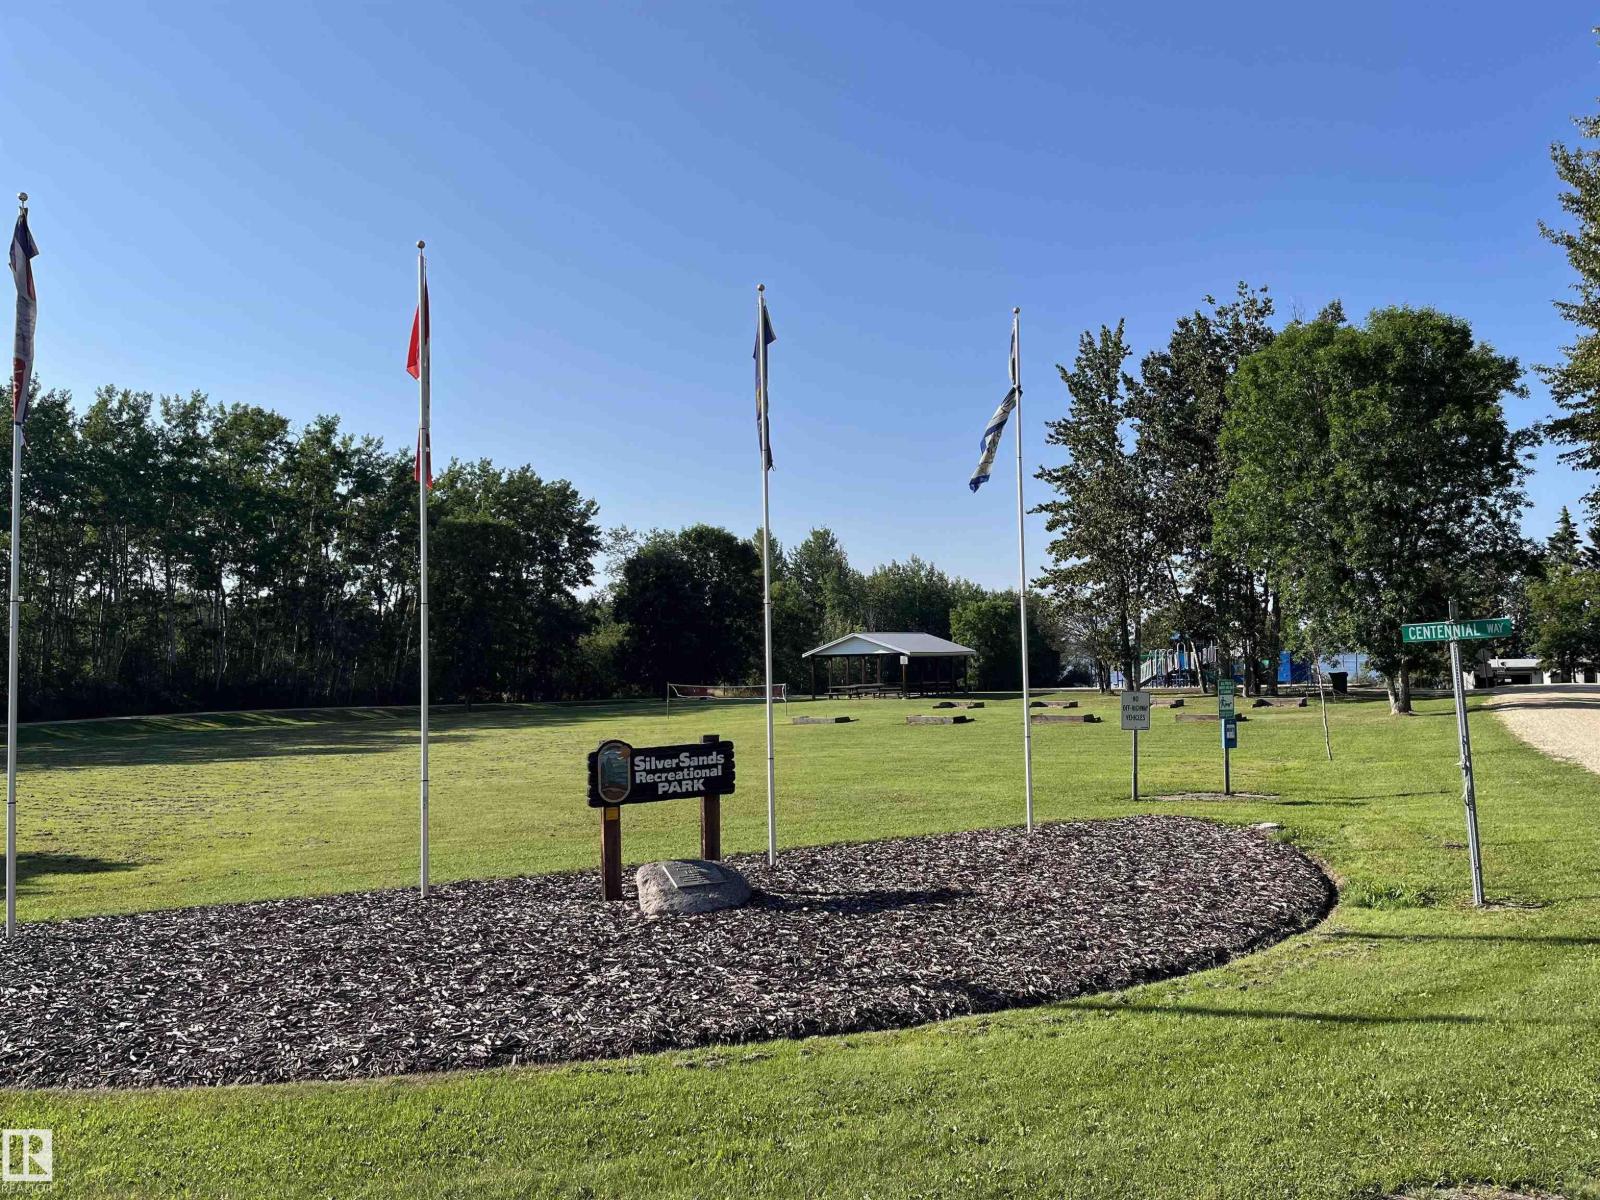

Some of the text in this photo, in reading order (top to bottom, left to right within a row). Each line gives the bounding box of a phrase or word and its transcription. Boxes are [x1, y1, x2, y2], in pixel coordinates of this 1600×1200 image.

[1408, 623, 1504, 640] CENTENNIAL WAY
[635, 765, 722, 784] Recreational
[657, 778, 705, 794] PARK
